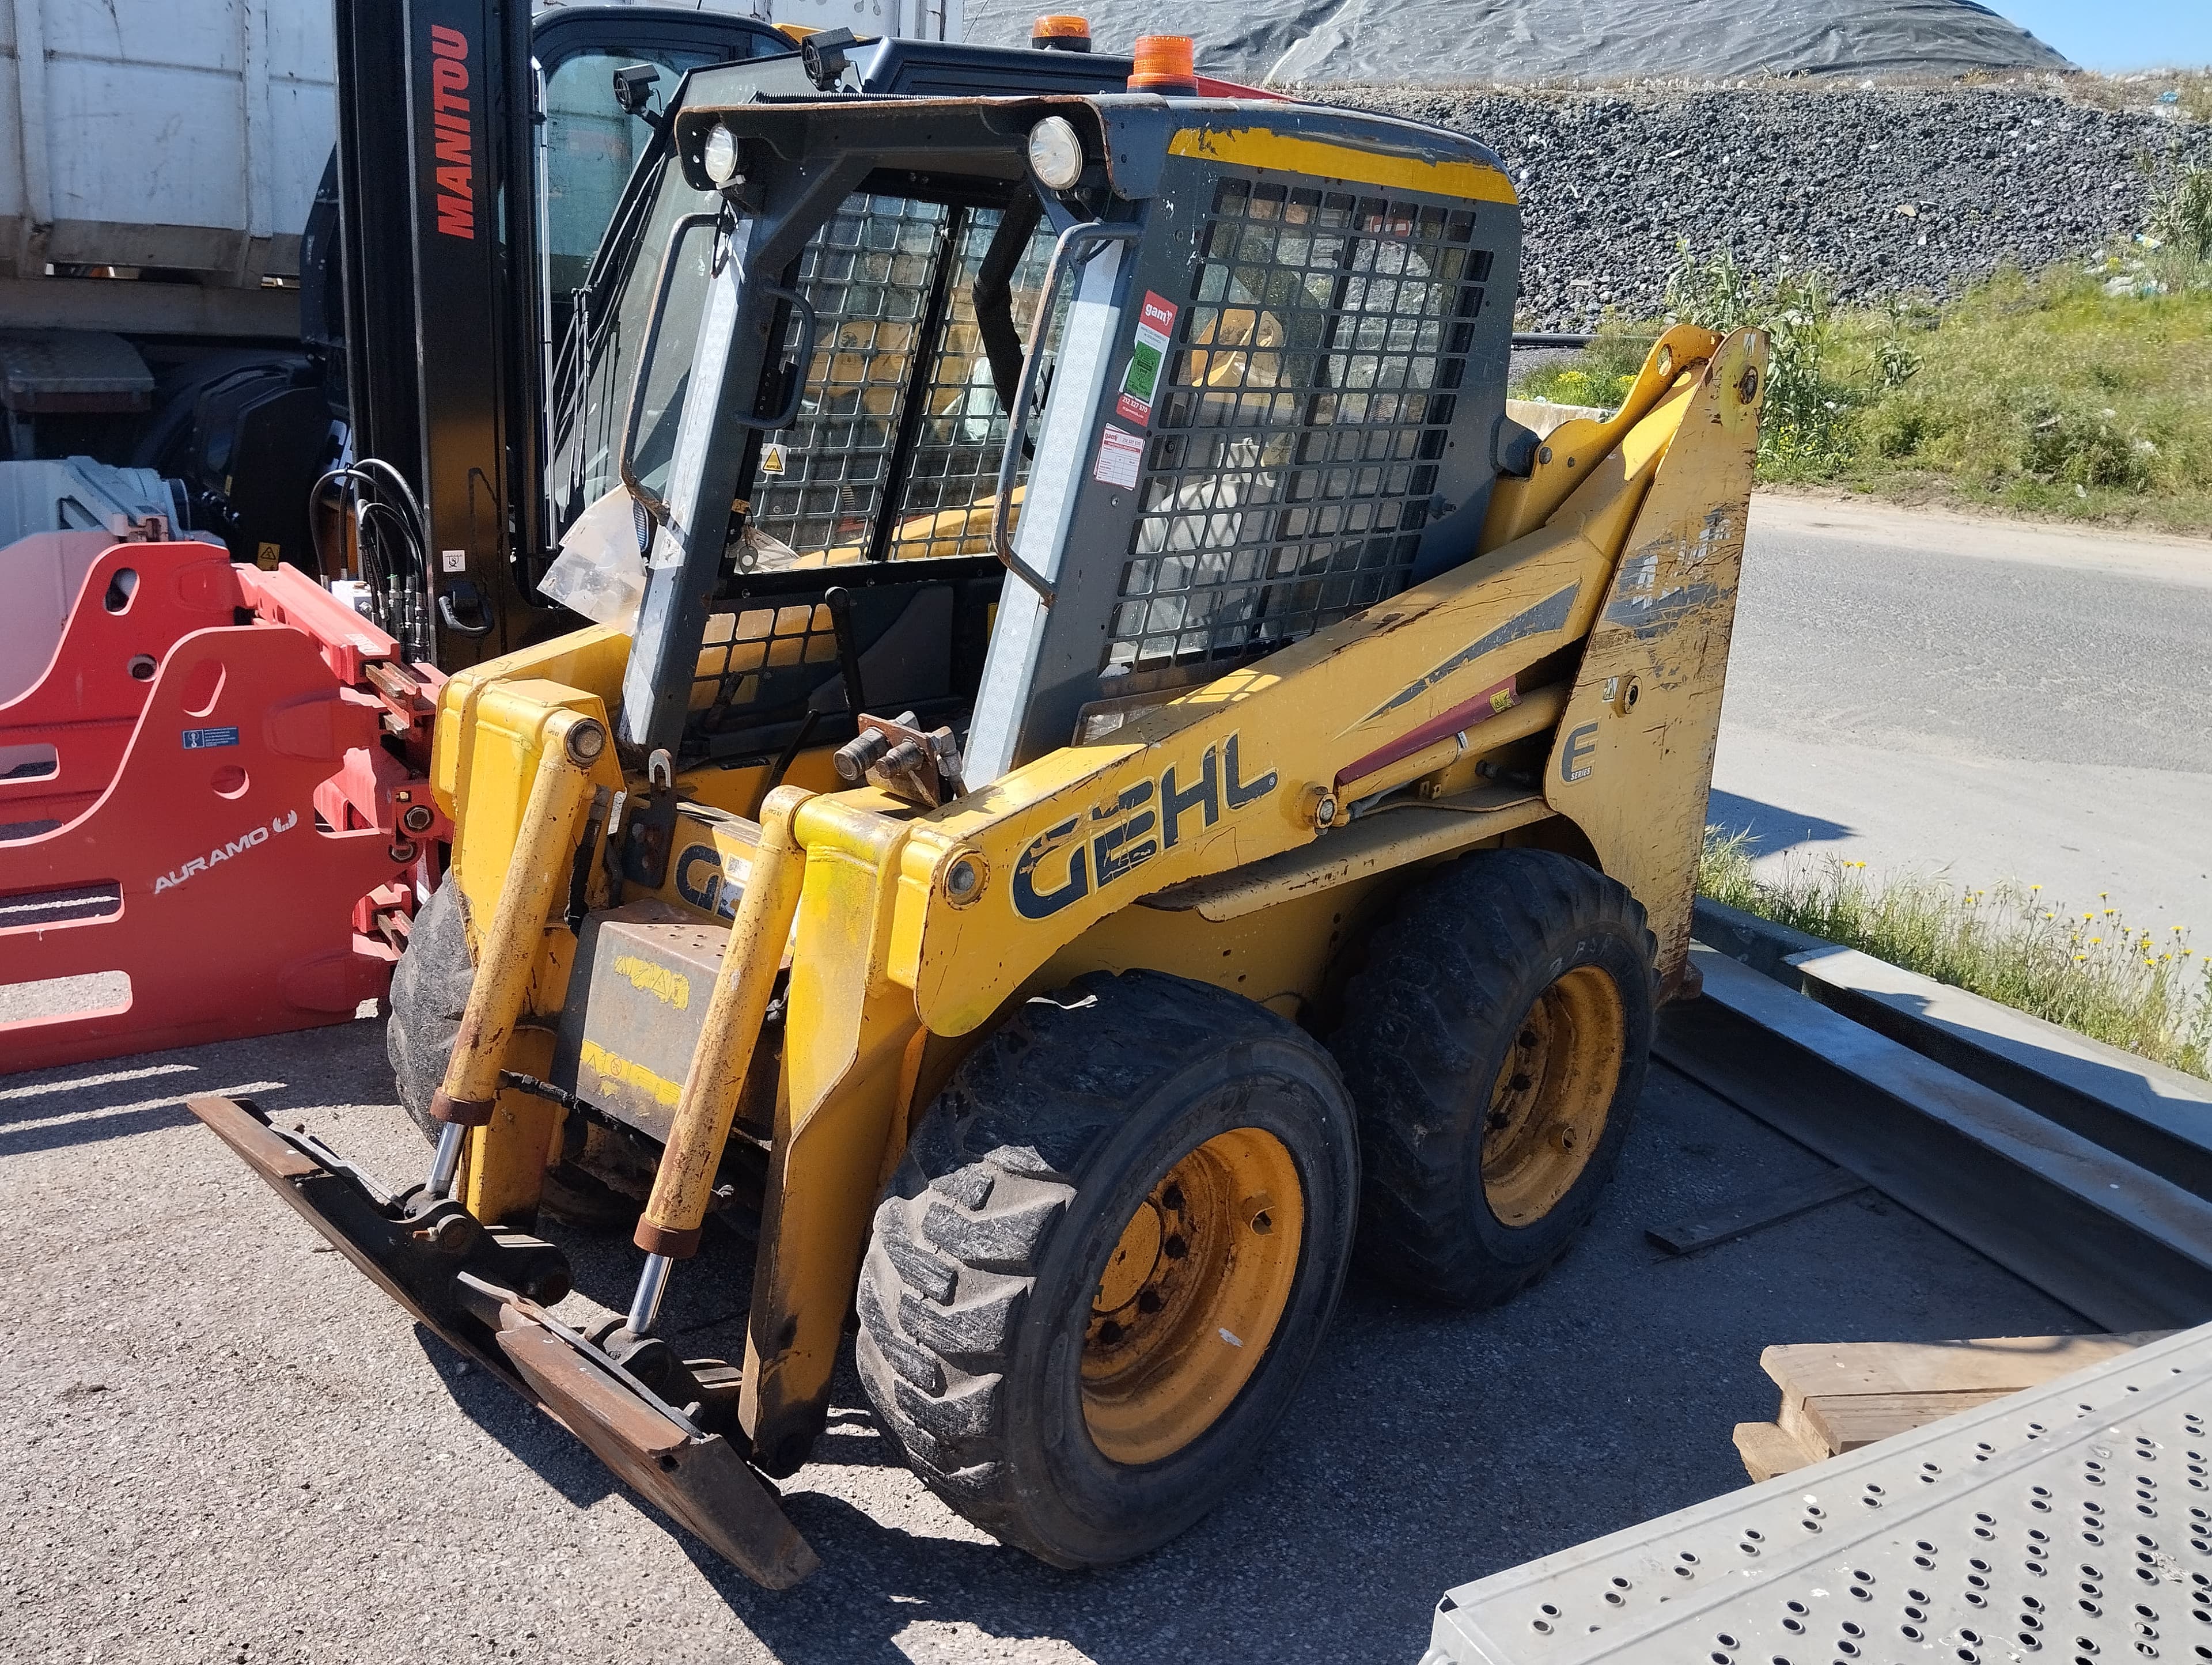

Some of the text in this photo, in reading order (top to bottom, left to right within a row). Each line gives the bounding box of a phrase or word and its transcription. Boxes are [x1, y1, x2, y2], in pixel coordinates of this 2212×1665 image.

[431, 25, 474, 240] MANITOU
[1561, 722, 1599, 782] E
[1570, 767, 1590, 780] SERIES
[1013, 732, 1278, 919] GEHL
[154, 826, 268, 894] AURAMO
